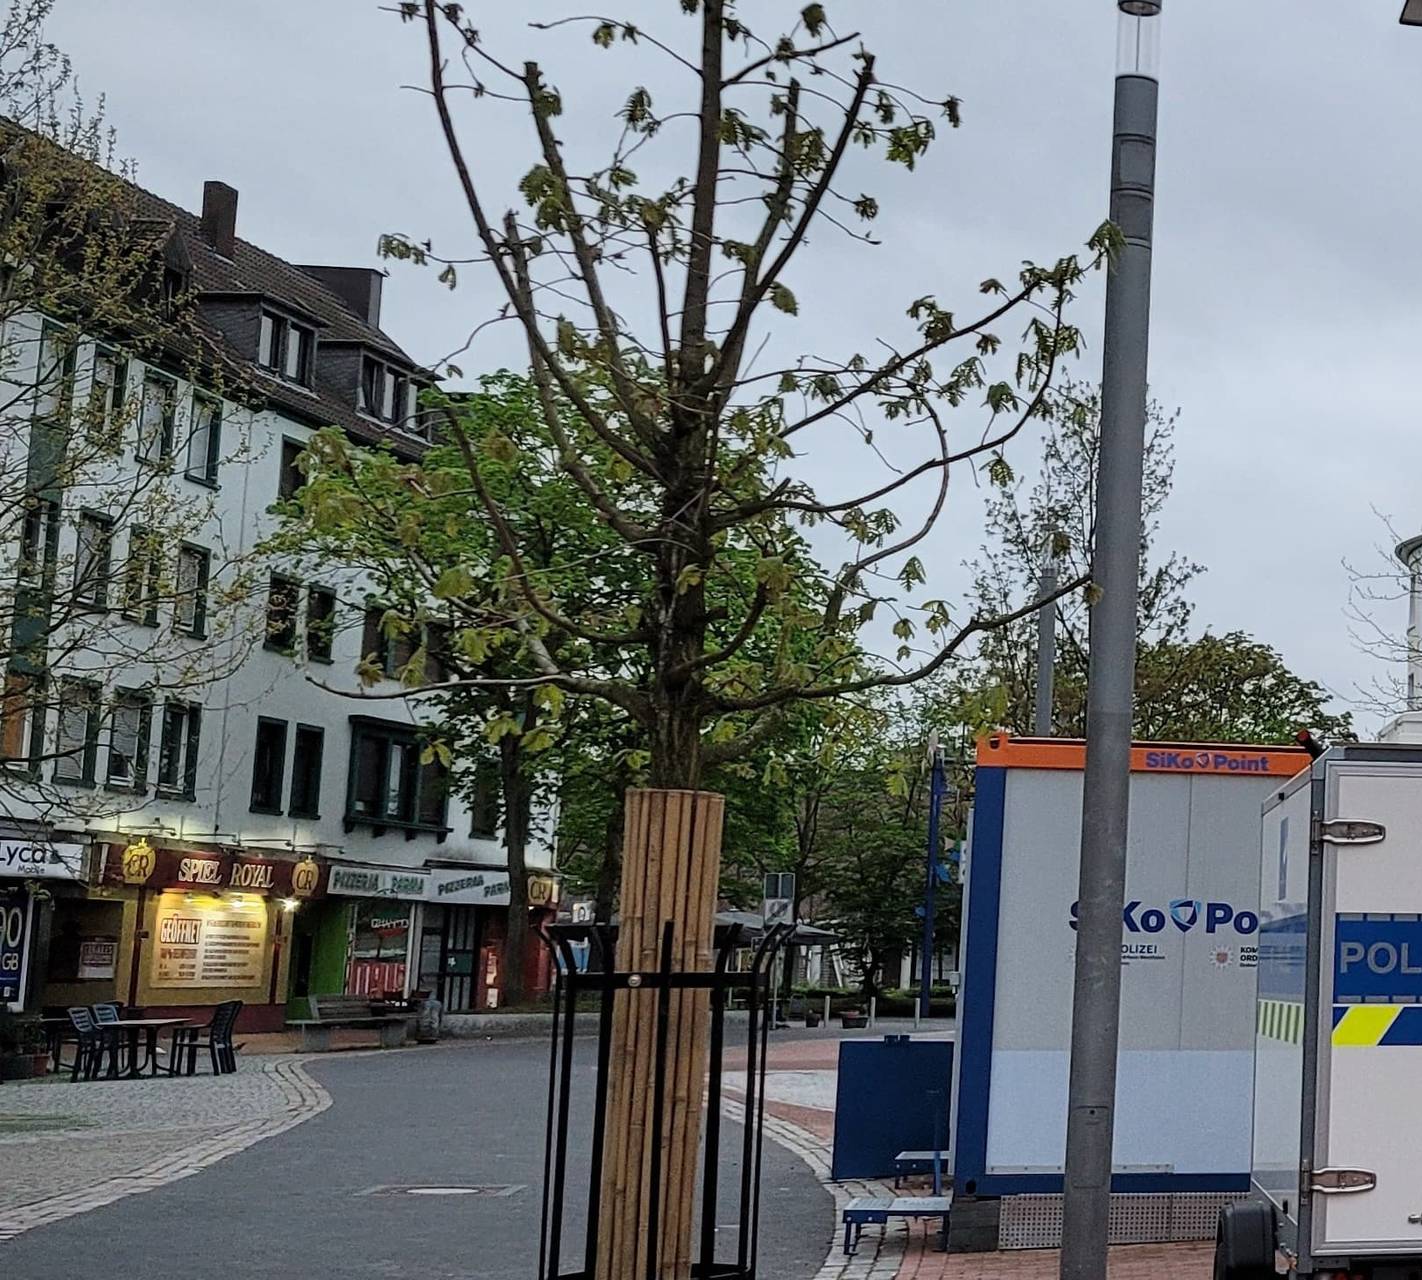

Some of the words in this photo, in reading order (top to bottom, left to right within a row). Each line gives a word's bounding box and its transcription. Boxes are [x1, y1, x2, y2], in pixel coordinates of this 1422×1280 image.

[1145, 752, 1194, 769] SiKo
[1213, 754, 1269, 771] Point
[178, 858, 223, 884] SPIEL
[229, 862, 275, 888] ROYAL
[333, 871, 379, 890] PIZZERIA
[437, 874, 484, 896] PIZZERIA
[1121, 945, 1158, 954] OLIZEI
[2, 952, 19, 970] GB
